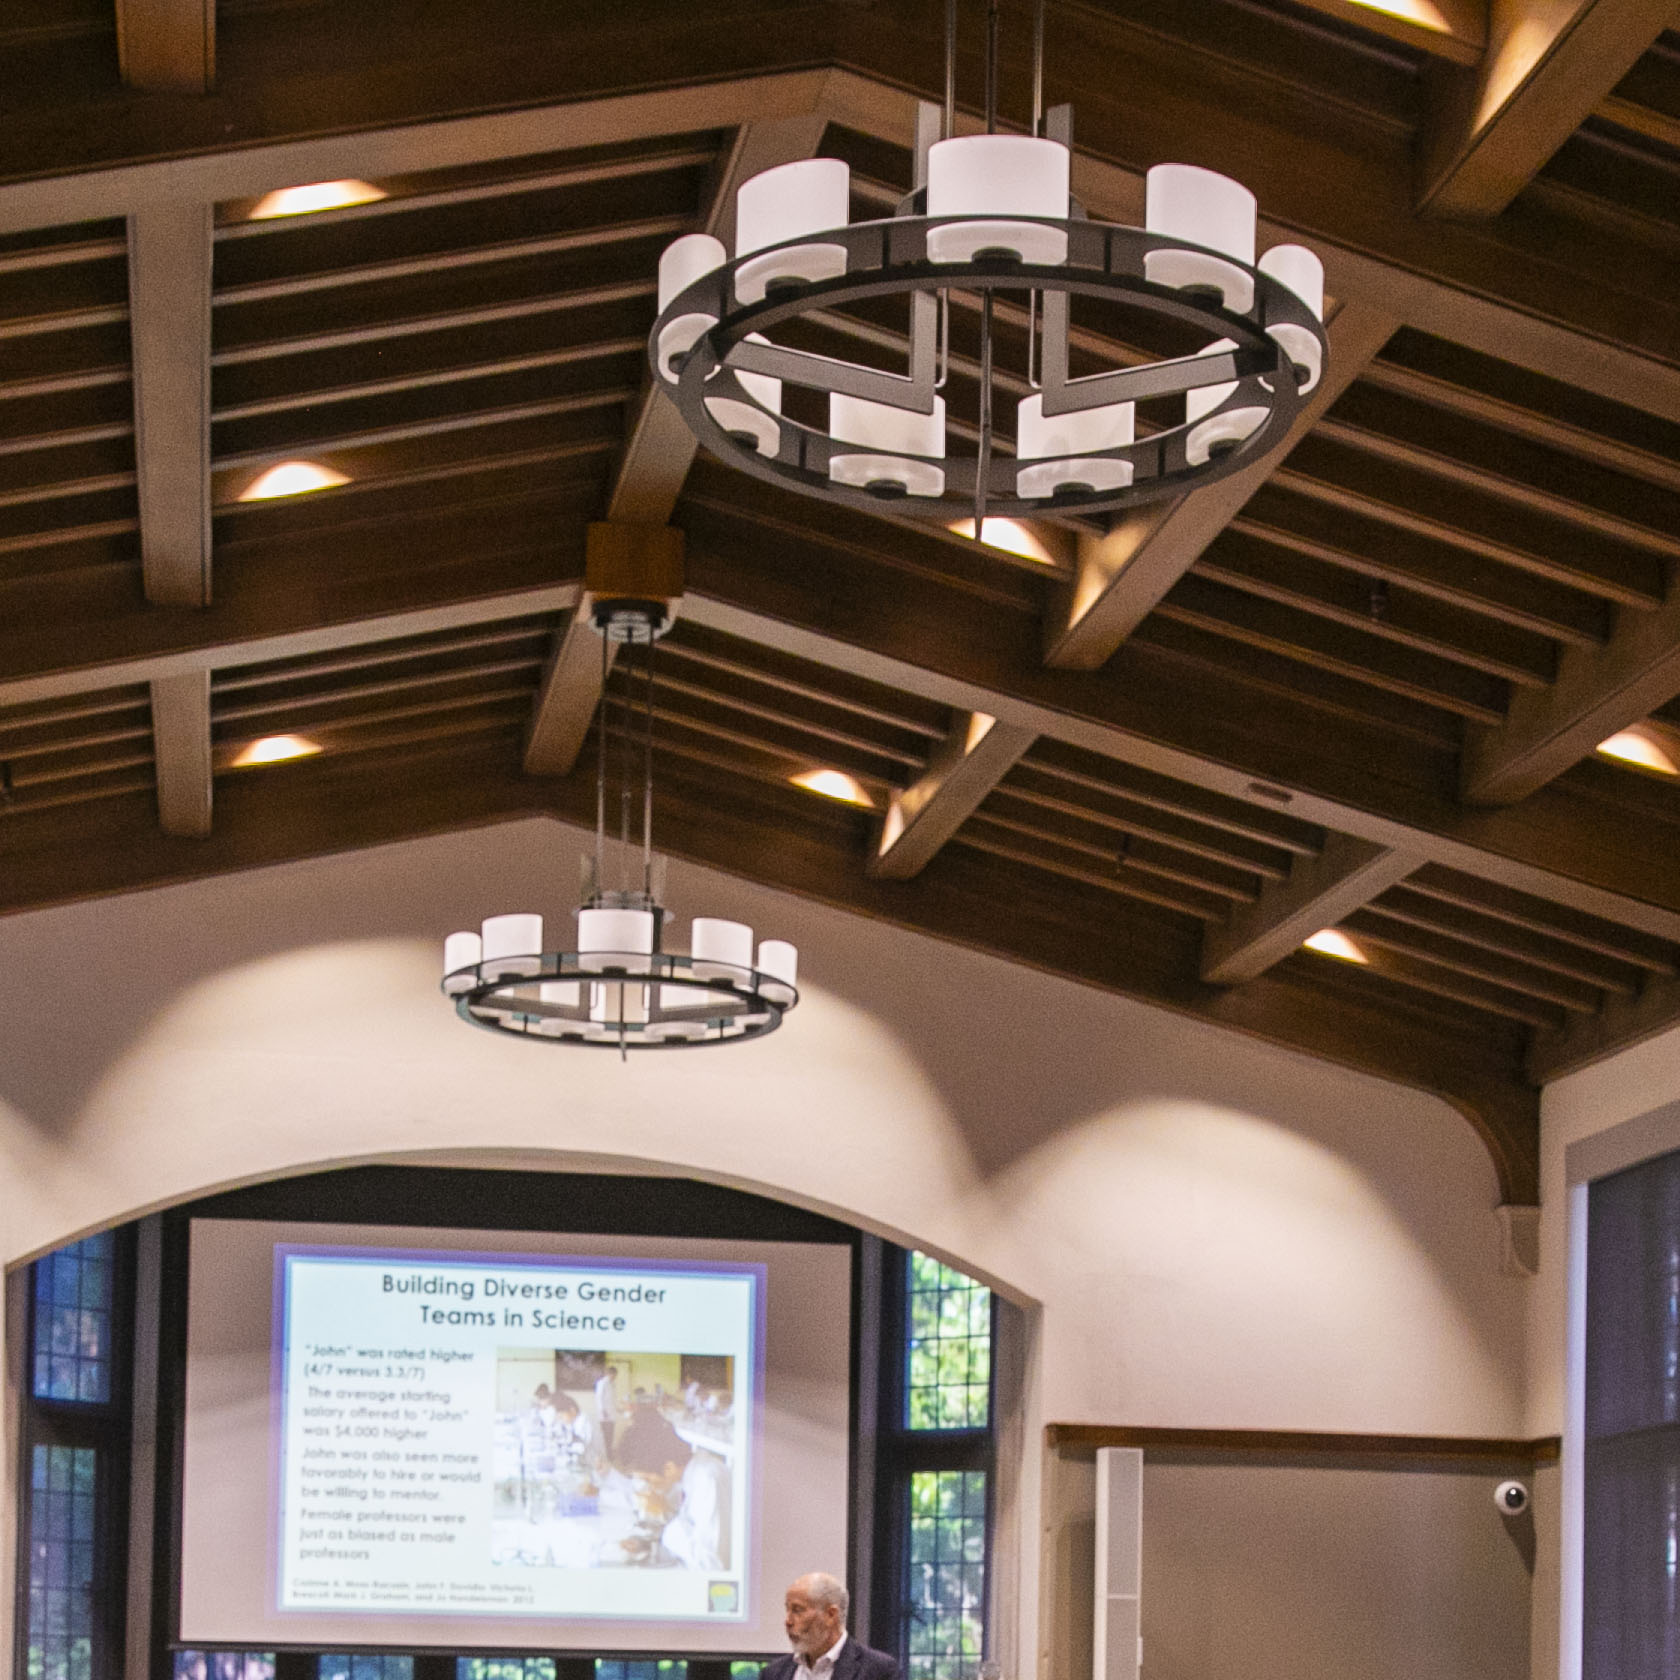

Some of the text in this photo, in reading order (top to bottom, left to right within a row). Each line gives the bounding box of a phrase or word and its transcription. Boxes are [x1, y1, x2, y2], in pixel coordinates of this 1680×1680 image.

[382, 1274, 667, 1304] Building Diverse Gender
[420, 1306, 626, 1331] Teams in Science
[357, 1349, 384, 1358] was
[387, 1348, 426, 1360] rated
[429, 1349, 474, 1364] higher
[337, 1366, 380, 1377] versus
[309, 1386, 451, 1404] The average starting
[303, 1406, 344, 1419] salary
[350, 1407, 399, 1420] offered
[404, 1409, 417, 1420] to
[303, 1427, 330, 1436] was
[383, 1427, 428, 1441] higher
[302, 1448, 479, 1463] John was also seen more
[300, 1466, 481, 1483] favorably to hire or would
[301, 1486, 320, 1497] be
[324, 1487, 368, 1501] willing
[373, 1488, 386, 1499] to
[300, 1508, 467, 1524] Female professors were
[299, 1528, 456, 1543] just as biased as male
[299, 1547, 370, 1561] professors
